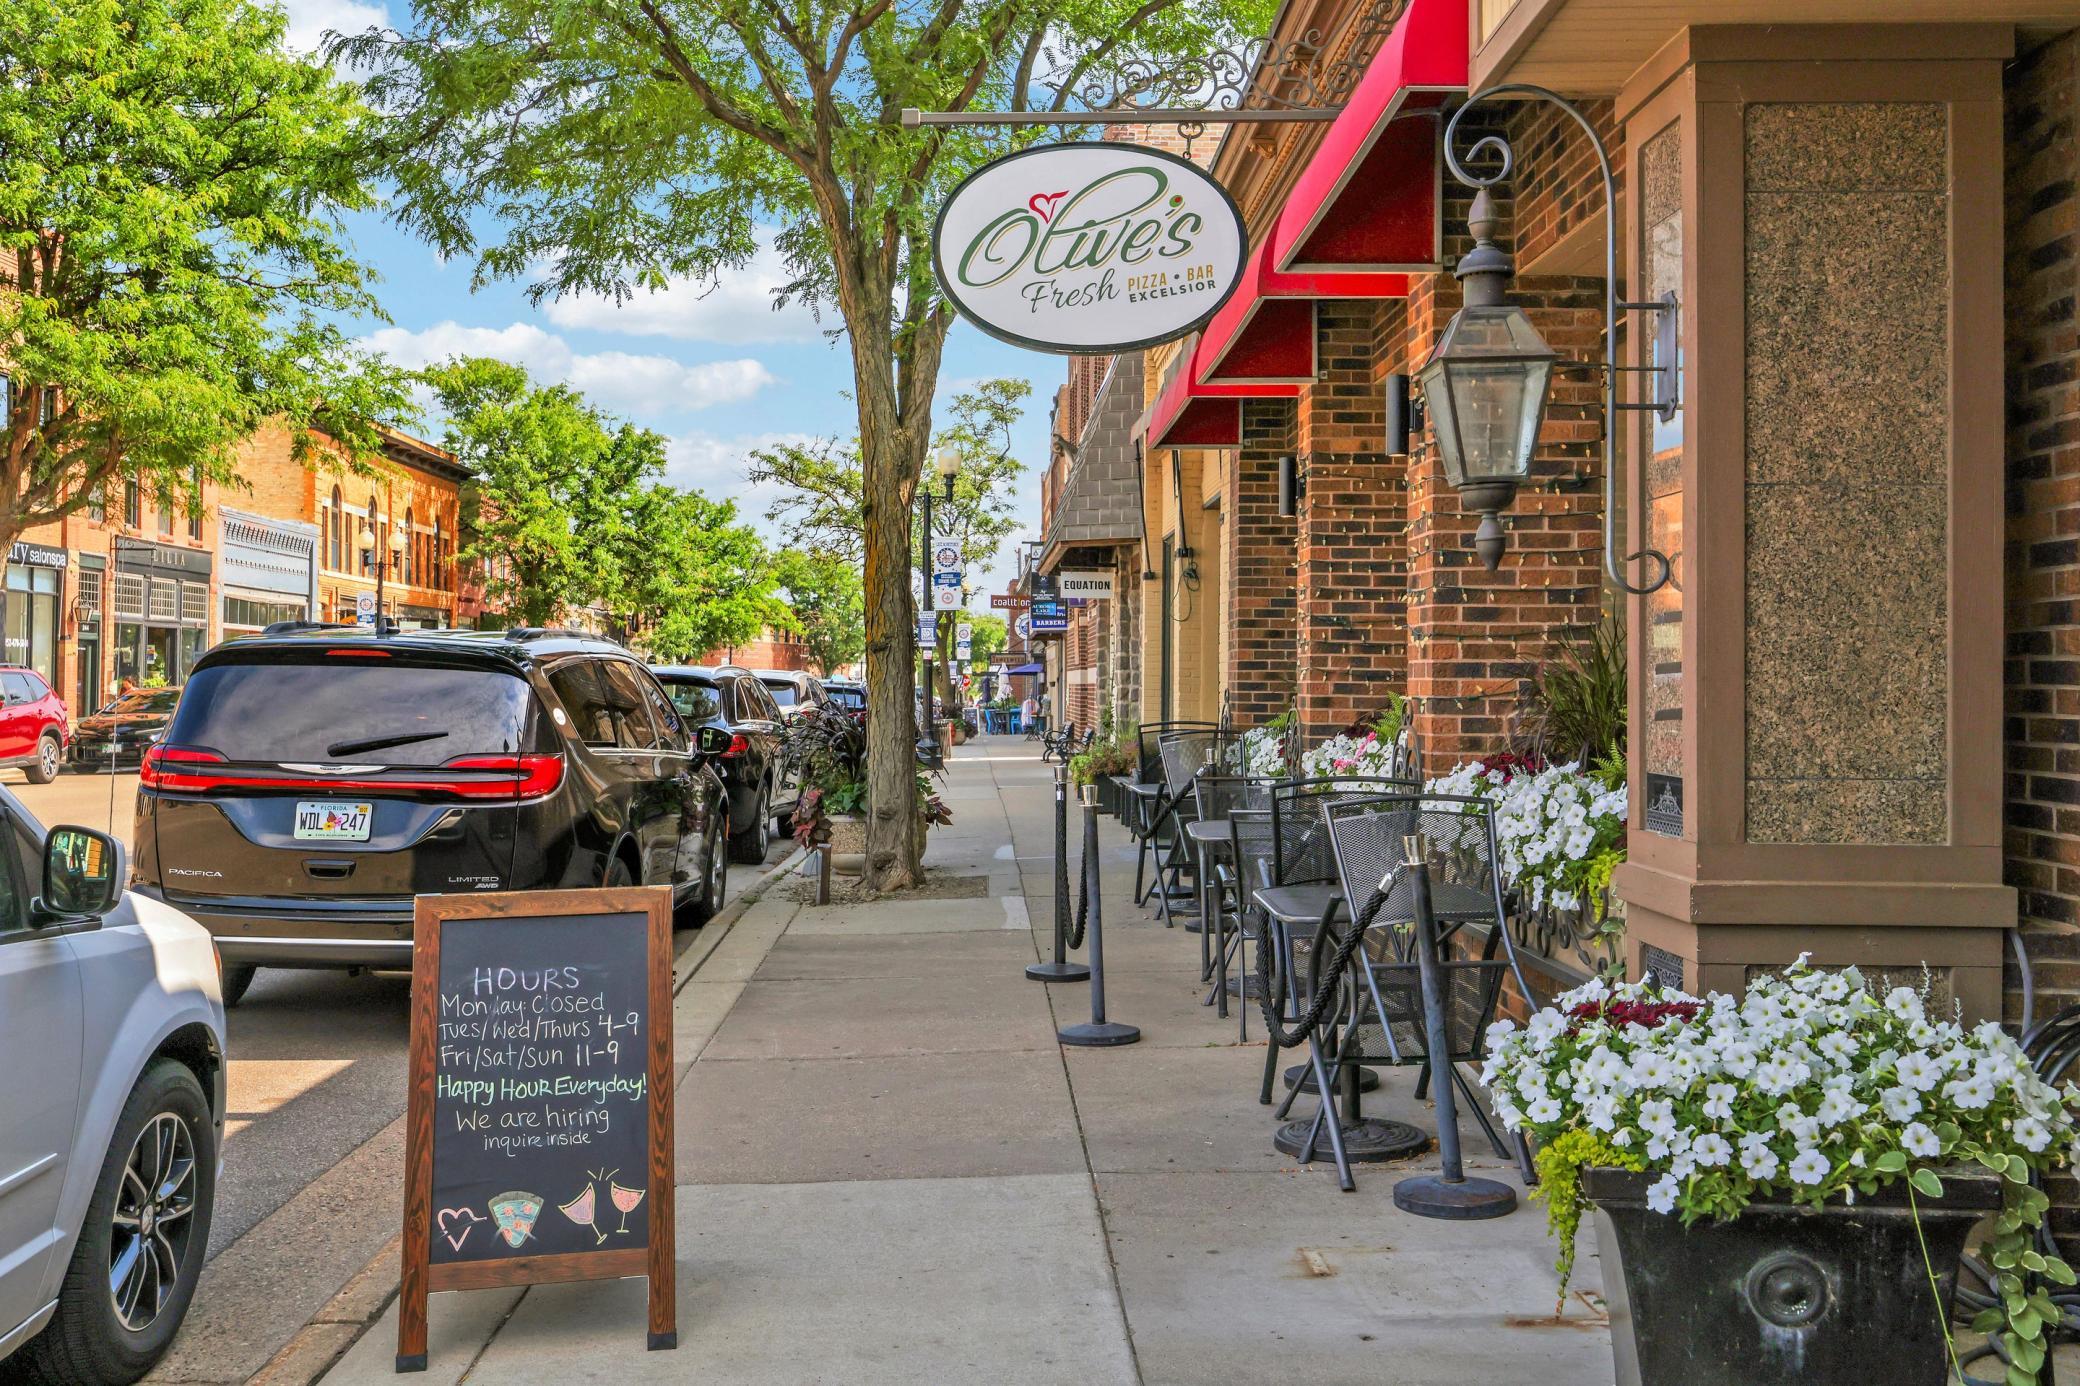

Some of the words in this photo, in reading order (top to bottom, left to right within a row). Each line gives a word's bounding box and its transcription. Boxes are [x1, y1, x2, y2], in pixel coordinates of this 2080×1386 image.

[1128, 272, 1167, 291] PIZZA
[1187, 264, 1214, 282] BAR
[1021, 269, 1121, 313] Fresh
[1129, 279, 1217, 303] EXCELSIOR
[29, 548, 66, 569] salonspa
[1064, 580, 1111, 590] EQUATION
[300, 812, 324, 830] WDL
[341, 813, 367, 831] 247
[169, 868, 222, 877] PACIFICA
[474, 966, 580, 995] HOURS
[598, 1012, 639, 1036] 4-9
[576, 1041, 619, 1067] 11-9
[438, 1074, 495, 1106] Happy
[555, 1073, 648, 1104] Everyday!
[456, 1110, 491, 1132] We
[500, 1111, 540, 1127] are
[545, 1104, 609, 1133] hiring
[484, 1134, 542, 1157] inquire
[546, 1131, 592, 1147] inside
